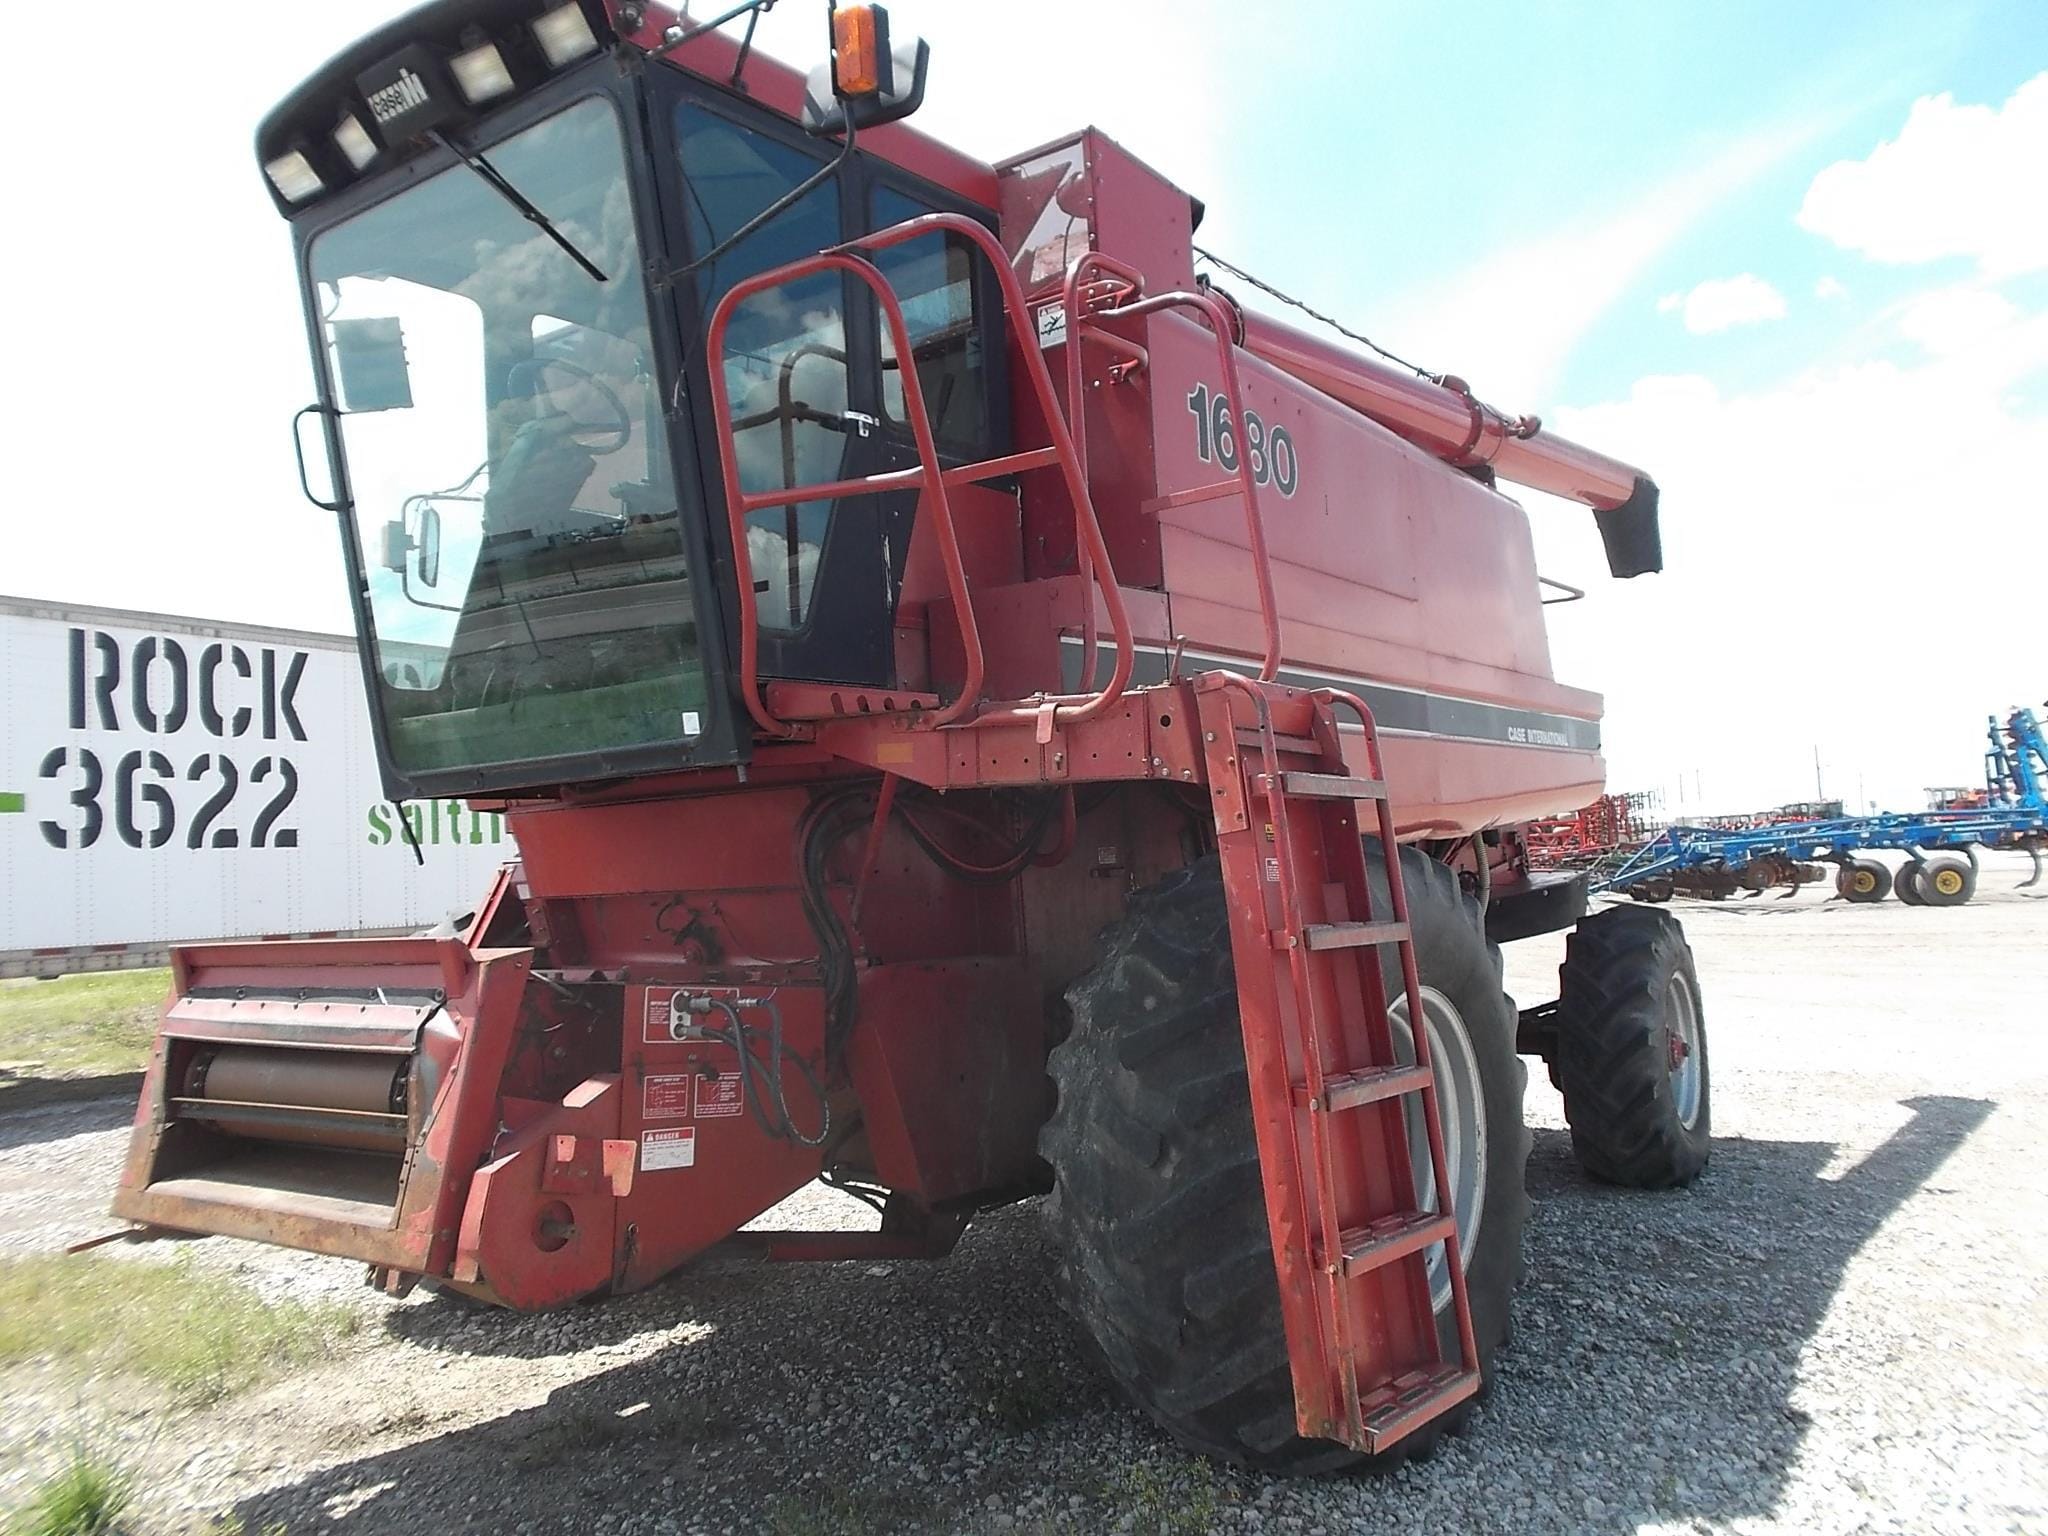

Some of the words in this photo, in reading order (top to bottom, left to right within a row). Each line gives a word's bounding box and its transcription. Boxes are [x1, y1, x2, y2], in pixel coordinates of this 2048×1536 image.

[1187, 381, 1298, 499] 1680
[68, 627, 309, 742] ROCK
[1507, 726, 1526, 742] CASE
[38, 745, 299, 850] 3622
